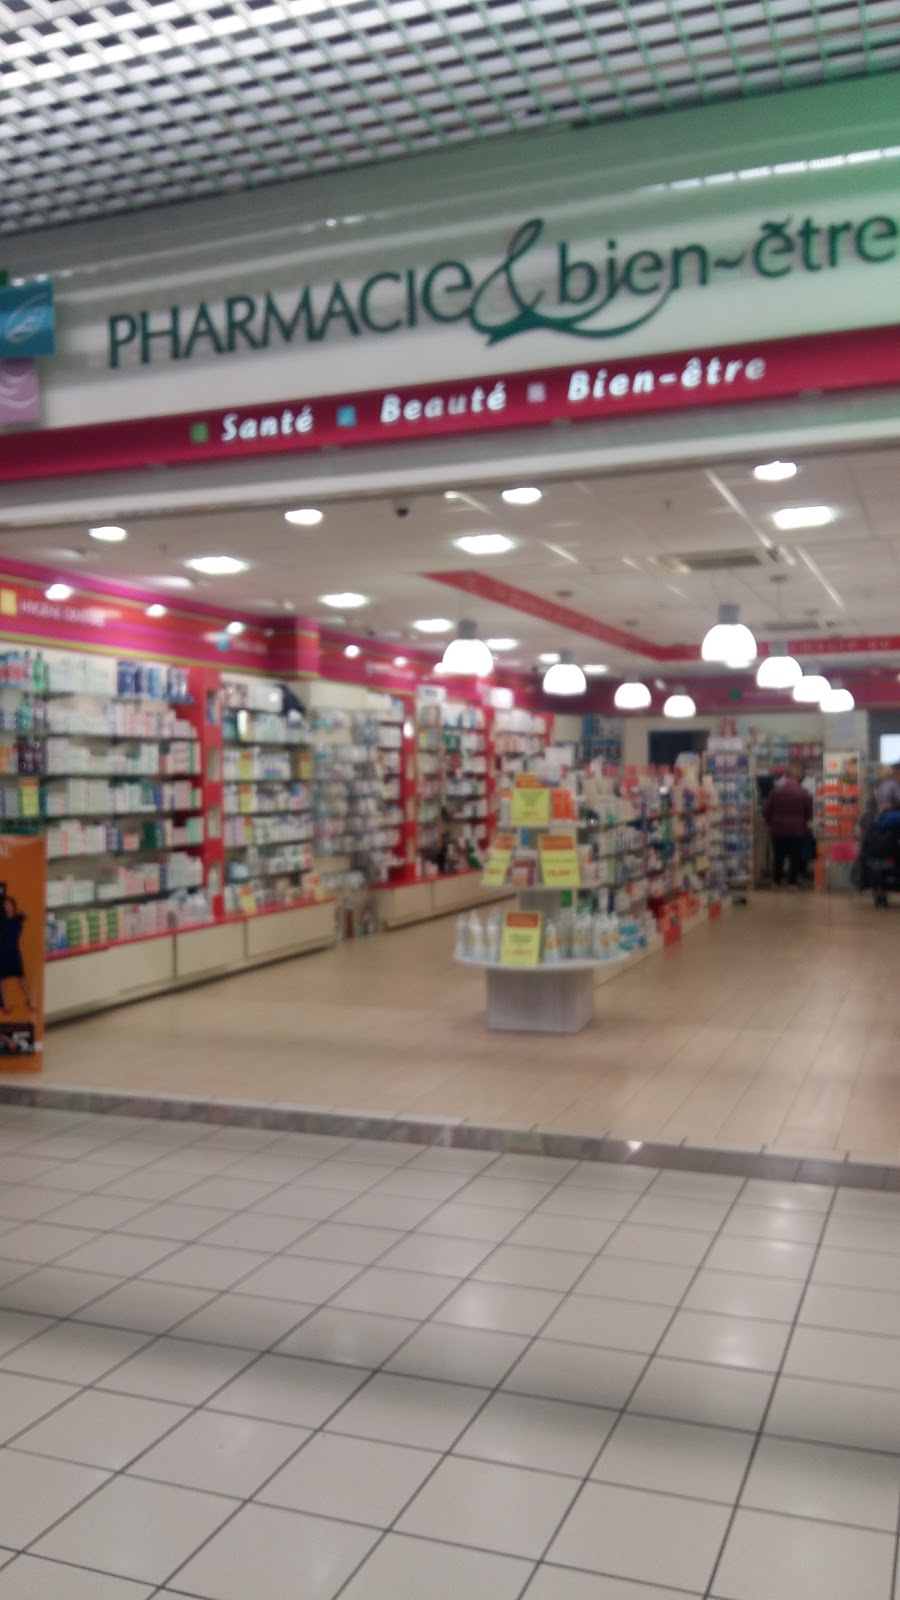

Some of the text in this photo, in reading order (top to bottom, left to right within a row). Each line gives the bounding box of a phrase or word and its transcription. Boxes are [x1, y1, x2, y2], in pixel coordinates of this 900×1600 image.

[220, 355, 768, 443] Santé Beauté Bien-être
